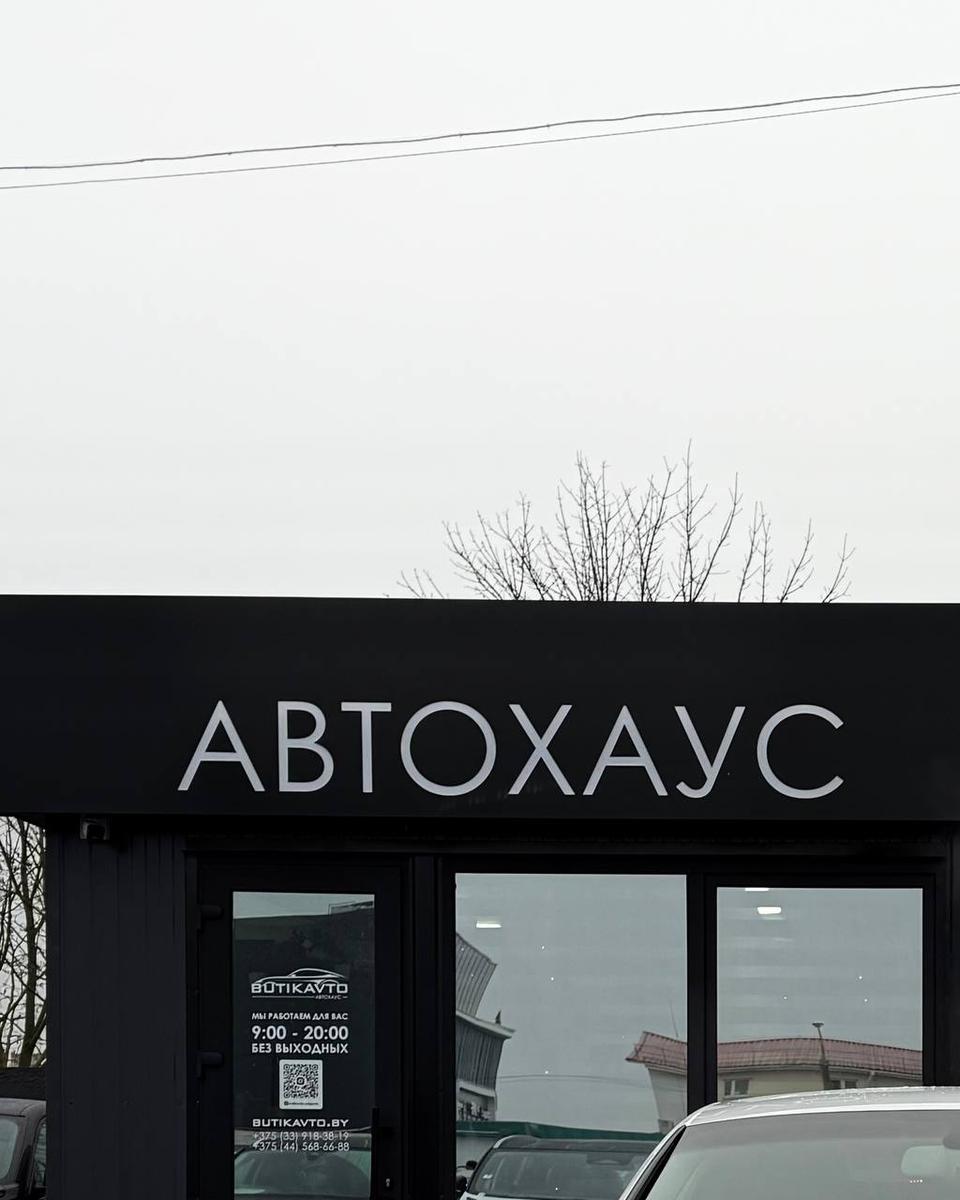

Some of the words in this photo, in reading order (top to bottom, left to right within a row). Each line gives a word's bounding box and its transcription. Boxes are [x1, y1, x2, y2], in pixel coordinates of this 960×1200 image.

[177, 700, 844, 799] АВТОХАУС
[251, 983, 348, 994] BUTIKAVTO
[251, 1012, 267, 1020] МЫ
[268, 1012, 311, 1021] РАБОТАЕМ
[311, 1012, 330, 1021] ДЛЯ
[331, 1012, 349, 1020] ВАС
[251, 1025, 287, 1041] 9:00
[303, 1025, 349, 1041] 20:00
[251, 1043, 272, 1054] БЕЗ
[275, 1043, 349, 1055] ВЫХОДНЫХ
[252, 1118, 349, 1128] BUTIKAVTO.BY
[253, 1131, 277, 1141] +375
[279, 1131, 299, 1142] (33)
[301, 1131, 350, 1141] 918-38-19
[280, 1141, 299, 1152] (44)
[301, 1141, 350, 1151] 568-66-88
